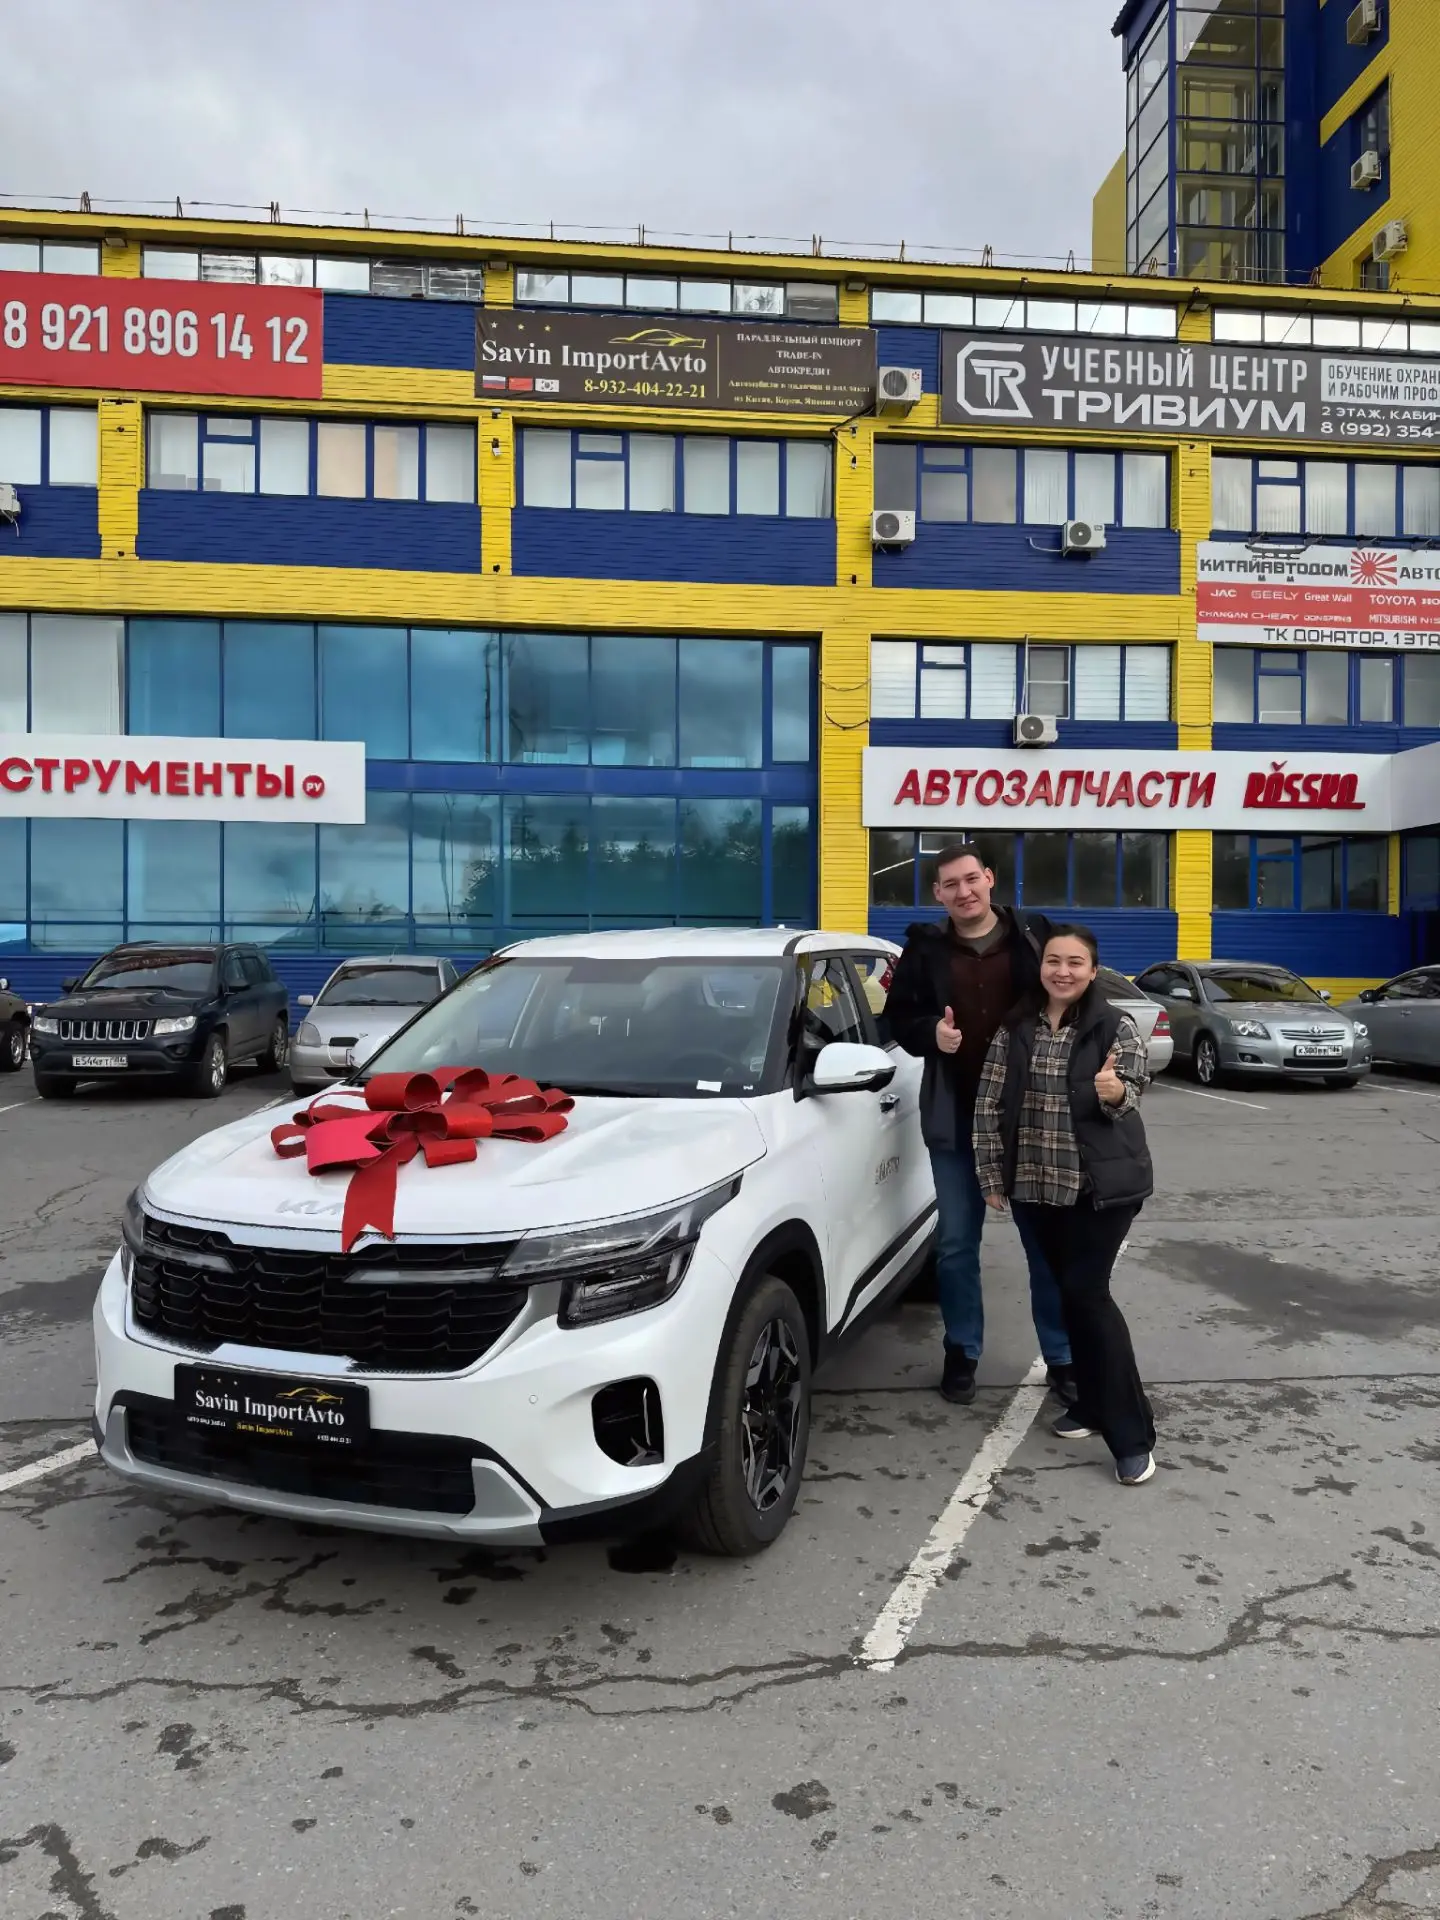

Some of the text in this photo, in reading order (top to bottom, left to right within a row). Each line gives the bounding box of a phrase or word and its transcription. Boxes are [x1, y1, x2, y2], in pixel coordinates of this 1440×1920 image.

[4, 301, 309, 364] 8 921 896 14 12
[736, 333, 862, 347] ПАРАЛЛЕЛЬНЫЙ ИМПОРТ
[482, 339, 707, 374] Savin ImportAvto
[776, 350, 822, 360] TRADE-IN
[768, 366, 830, 376] АВТОКРЕДИТ
[1041, 345, 1307, 394] УЧЕБНЫЙ ЦЕНТР
[1328, 364, 1392, 382] ОБУЧЕНИЕ
[584, 379, 706, 399] 8-932-404-22-21
[1328, 382, 1336, 396] И
[1340, 382, 1399, 400] РАБОЧИМ
[1042, 388, 1306, 433] ТРИВИУМ
[1321, 406, 1331, 416] 2
[1336, 407, 1385, 420] ЭТАЖ,
[1321, 421, 1333, 434] 8
[1340, 422, 1391, 437] (992)
[1210, 589, 1237, 598] JAC
[1251, 590, 1299, 600] GEELY
[1304, 592, 1329, 602] Great
[1332, 593, 1352, 602] Wall
[1369, 594, 1416, 605] TOYOTA
[1199, 610, 1248, 619] CHANGAN
[1251, 613, 1299, 621] CHERY
[1369, 614, 1417, 624] MITSUBISHI
[1264, 628, 1288, 641] ТК
[1393, 632, 1400, 645] 1
[0, 757, 295, 799] СТРУМЕНТЫ
[894, 768, 1217, 809] АВТОЗАПЧАСТИ
[195, 1389, 239, 1413] Savin
[244, 1396, 345, 1426] ImportAvto
